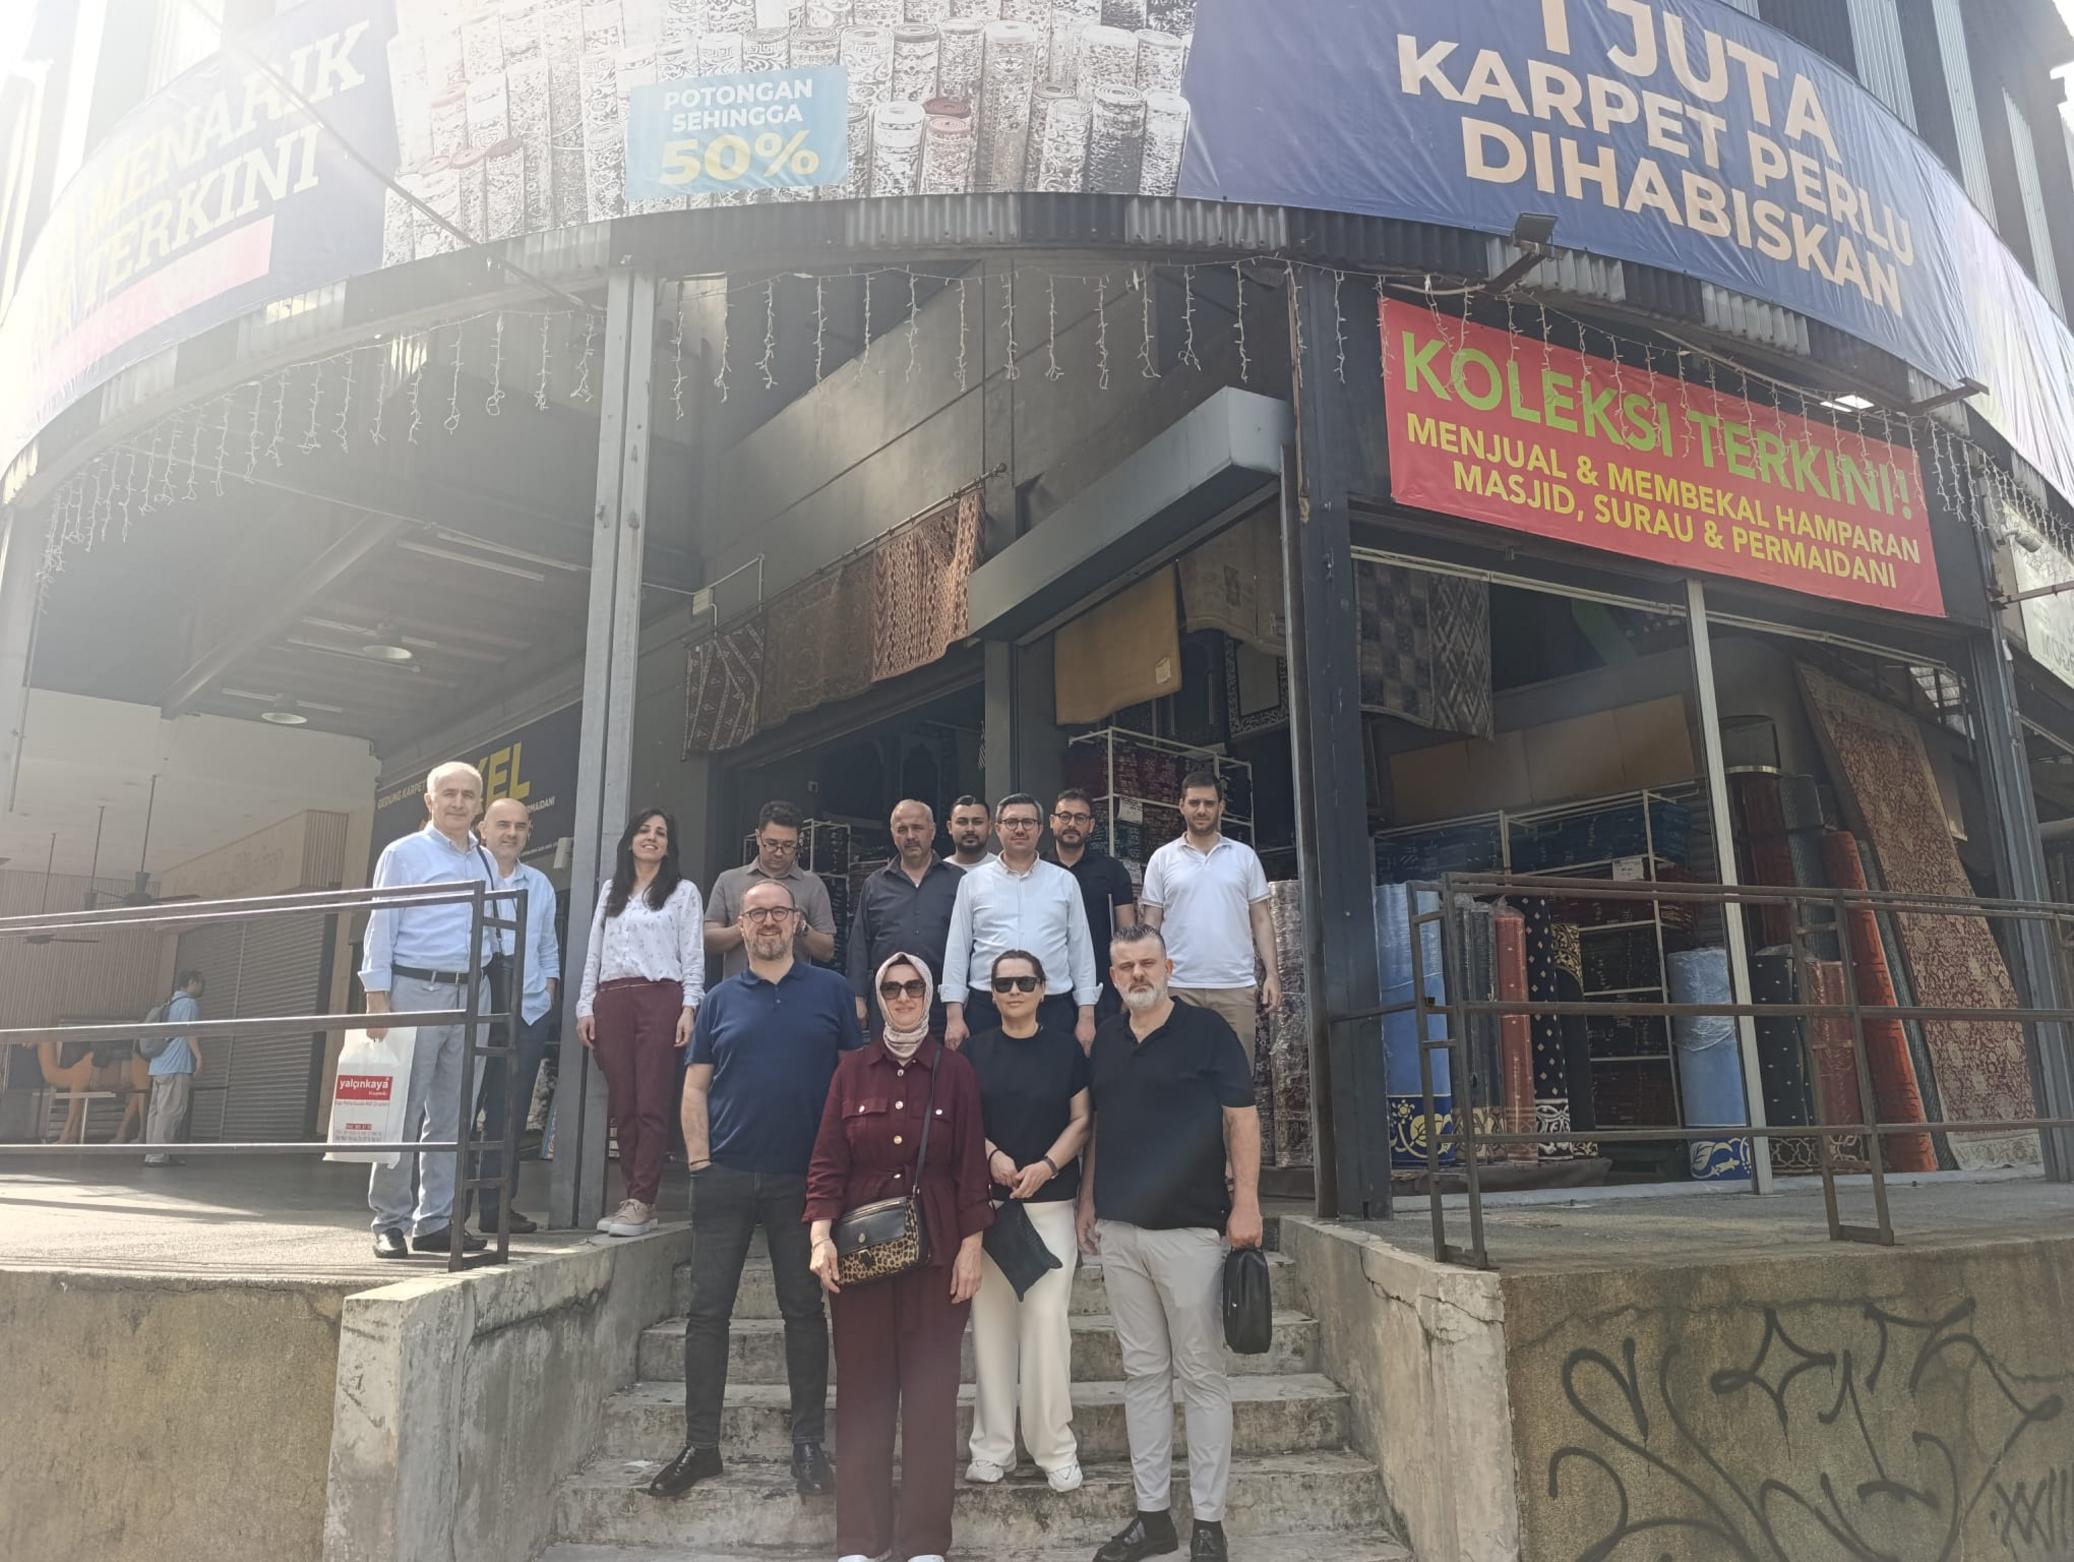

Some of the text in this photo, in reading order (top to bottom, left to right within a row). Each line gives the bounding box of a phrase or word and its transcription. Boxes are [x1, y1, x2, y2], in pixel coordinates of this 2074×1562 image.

[664, 79, 812, 110] POTONGAN
[672, 104, 803, 131] SEHINGGA
[1397, 34, 1913, 267] KARPET PERLU
[1607, 3, 1841, 164] JUTA
[657, 129, 819, 186] 50%
[1461, 116, 1902, 319] DIHABISKAN
[1402, 330, 1912, 520] KOLEKSI TERKINI!
[1407, 412, 1921, 564] MENJUAL & MEMBEKAL HAMPARAN
[1453, 461, 1896, 590] MASJID, SURAU & PERMAIDANI
[470, 742, 530, 803] EL
